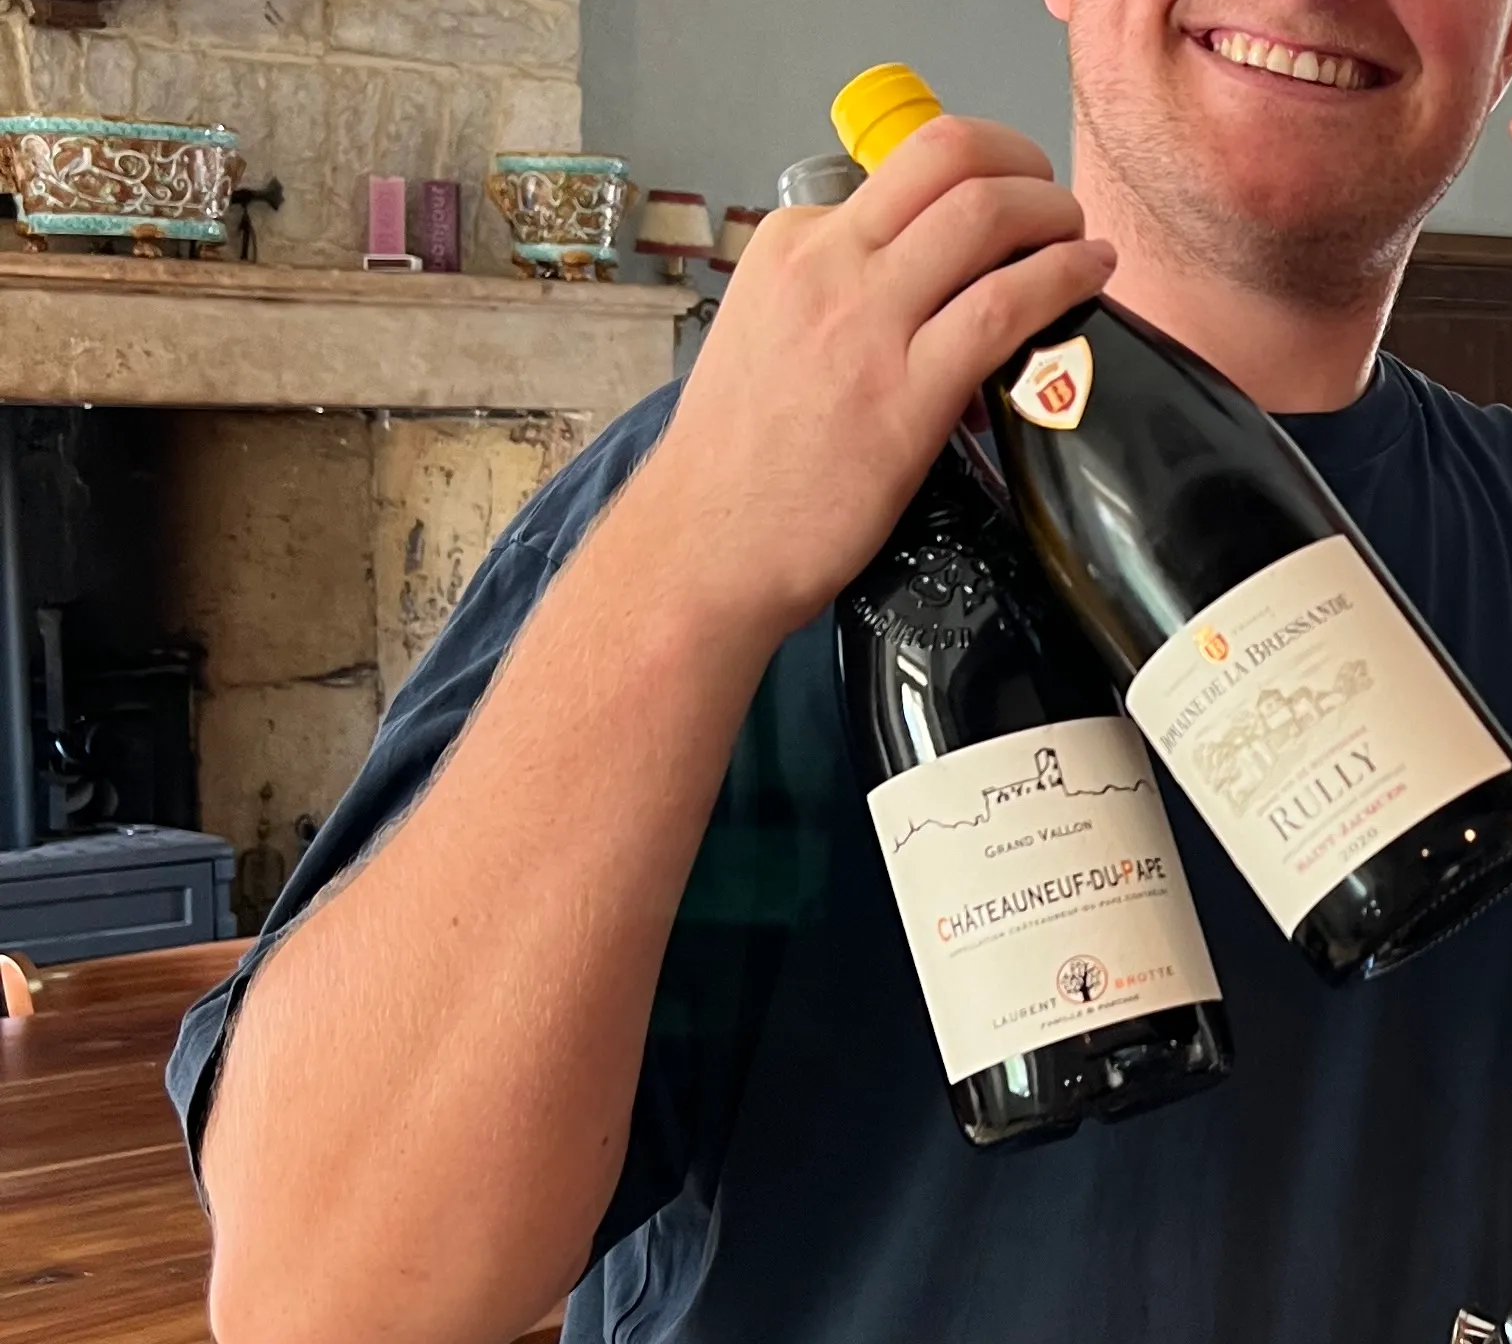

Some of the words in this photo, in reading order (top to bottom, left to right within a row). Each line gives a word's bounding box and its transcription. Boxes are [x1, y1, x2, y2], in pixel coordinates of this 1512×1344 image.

[1159, 697, 1208, 754] DOMAINE
[1202, 678, 1228, 705] DE
[1224, 661, 1251, 688] LA
[1245, 592, 1354, 668] BRESSANDE
[1268, 742, 1377, 842] RULLY
[984, 835, 1035, 858] GRAND
[1037, 819, 1093, 842] VALLON
[993, 997, 1058, 1030] LAURENT
[1114, 965, 1174, 990] BROTTE
